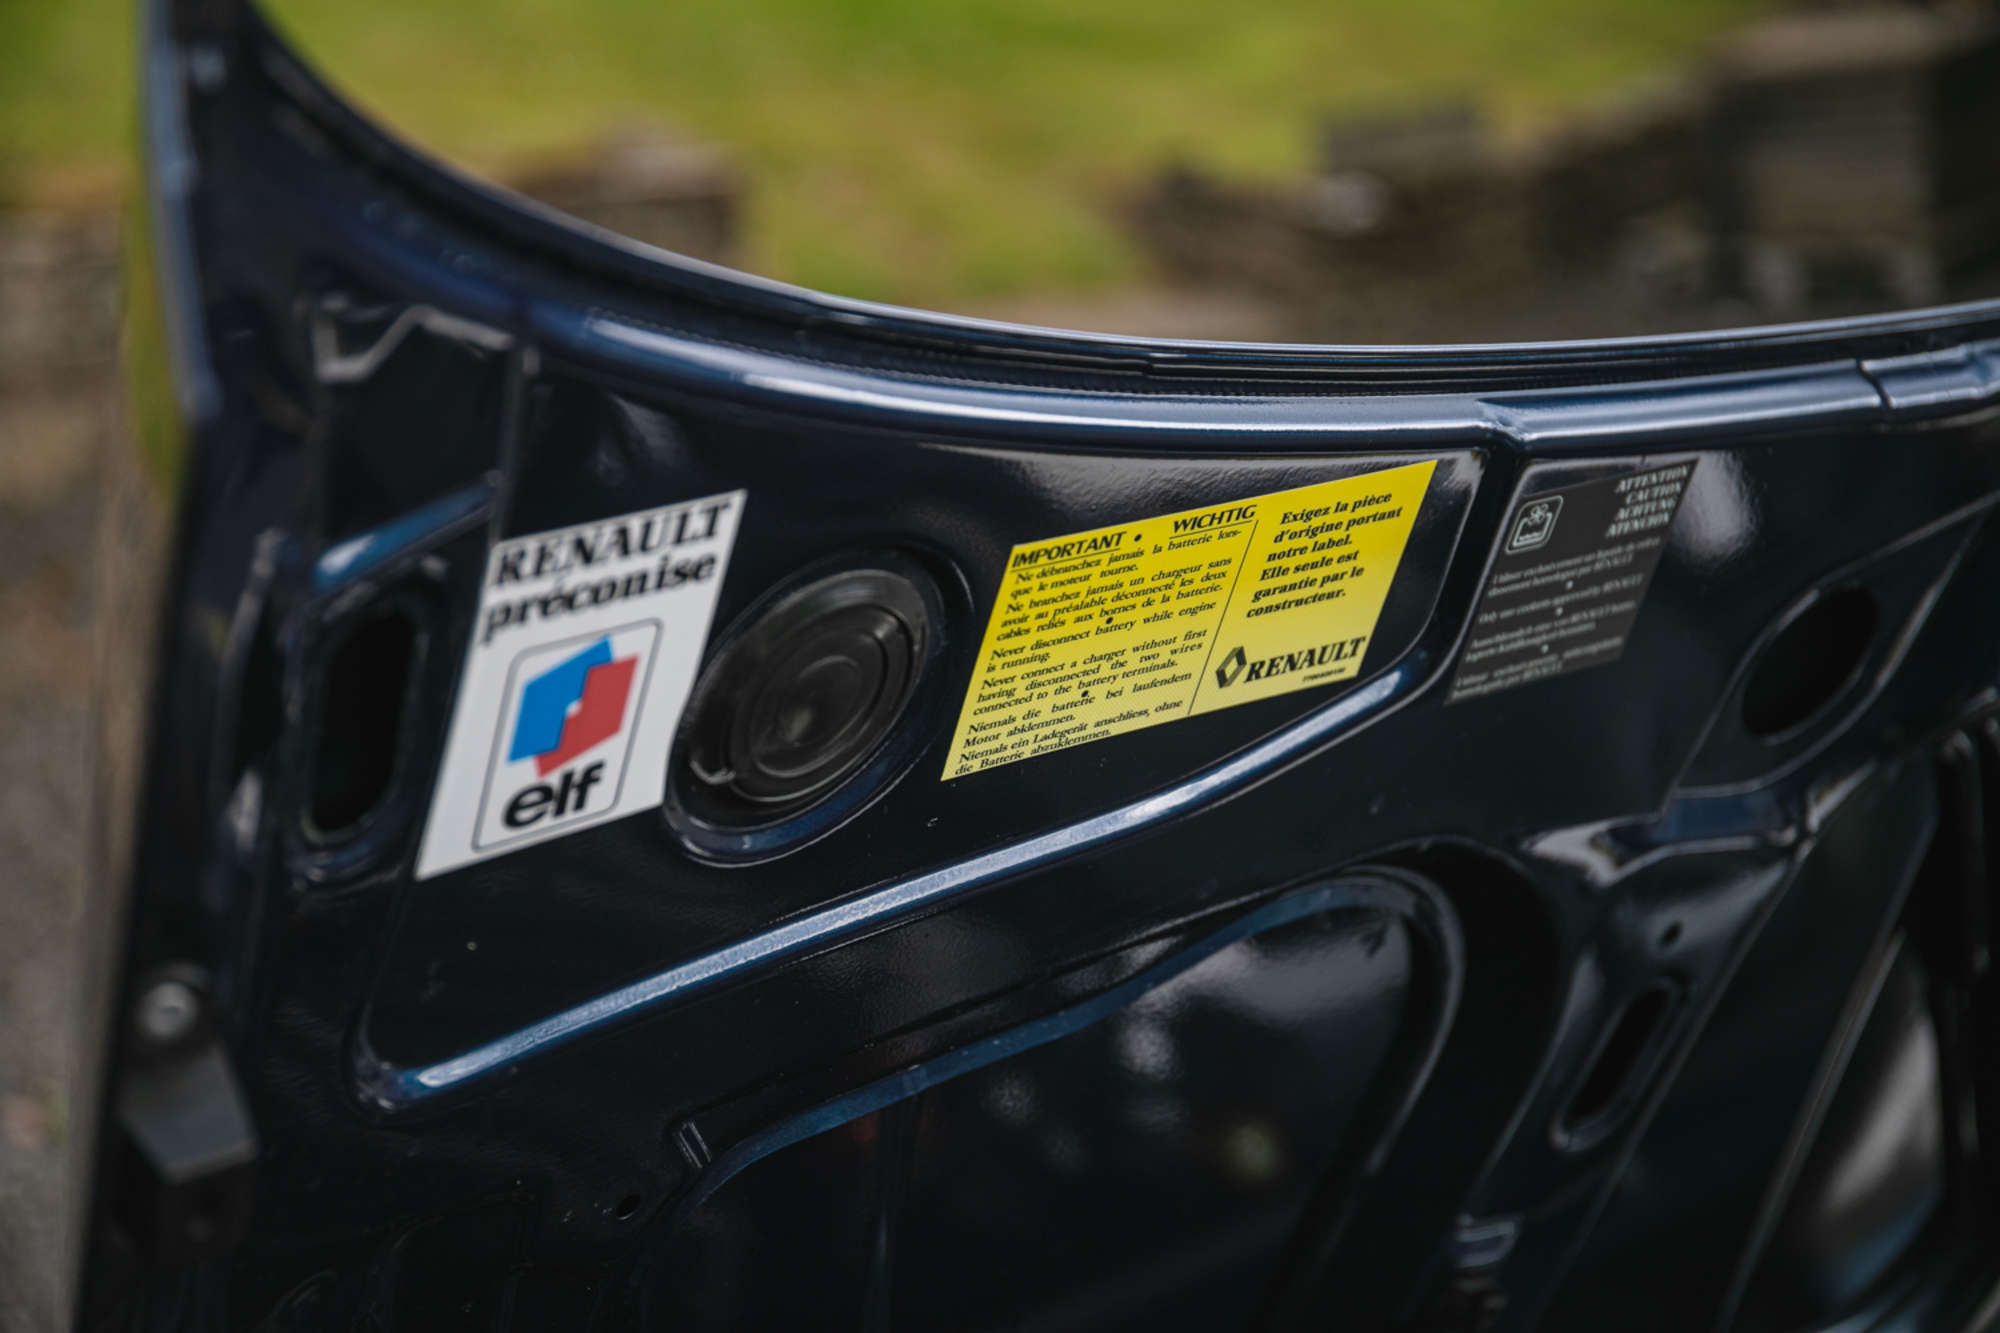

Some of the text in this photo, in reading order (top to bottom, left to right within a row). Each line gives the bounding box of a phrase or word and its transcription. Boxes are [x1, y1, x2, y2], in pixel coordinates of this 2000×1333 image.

[1279, 493, 1392, 525] Exigez la pièce
[1344, 506, 1402, 531] portant
[494, 503, 732, 586] RENAULT
[1011, 504, 1256, 568] IMPORTANT WICHTIG
[1015, 572, 1033, 584] Ne
[1107, 548, 1144, 566] jamais
[1151, 544, 1162, 554] la
[1167, 533, 1212, 550] batterie
[1266, 533, 1352, 562] notre label.
[1005, 602, 1024, 614] Ne
[1084, 579, 1124, 598] jamais
[1128, 576, 1144, 586] un
[1150, 563, 1202, 581] chargeur
[1207, 557, 1232, 569] sans
[1010, 563, 1138, 599] que le moteur tourne.
[1251, 565, 1364, 603] garantie par le
[1259, 549, 1359, 581] Elle seule est
[482, 552, 717, 647] préconise
[1000, 571, 1226, 628] avoir au préalable déconnecté les deux
[1073, 613, 1093, 623] aux
[1098, 602, 1136, 617] bornes
[1141, 597, 1155, 608] de
[1159, 593, 1170, 603] la
[1175, 583, 1222, 600] batterie.
[1245, 588, 1345, 618] constructeur.
[990, 601, 1216, 660] Never disconnect battery while engine
[976, 642, 1202, 703] having disconnected the two wires
[980, 629, 1207, 690] Never connect a charger without first
[985, 652, 1050, 673] is running.
[1243, 635, 1366, 683] RENAULT
[967, 672, 1191, 734] Niemals die batterie bei laufendem
[972, 658, 1177, 716] connected to the battery terminals.
[958, 743, 1008, 763] Niemals
[1010, 738, 1029, 749] ein
[1154, 700, 1183, 712] ohne
[962, 714, 1075, 748] Motor abklemmen.
[954, 763, 973, 775] die
[979, 749, 1024, 768] Batterie
[502, 761, 607, 829] elf
